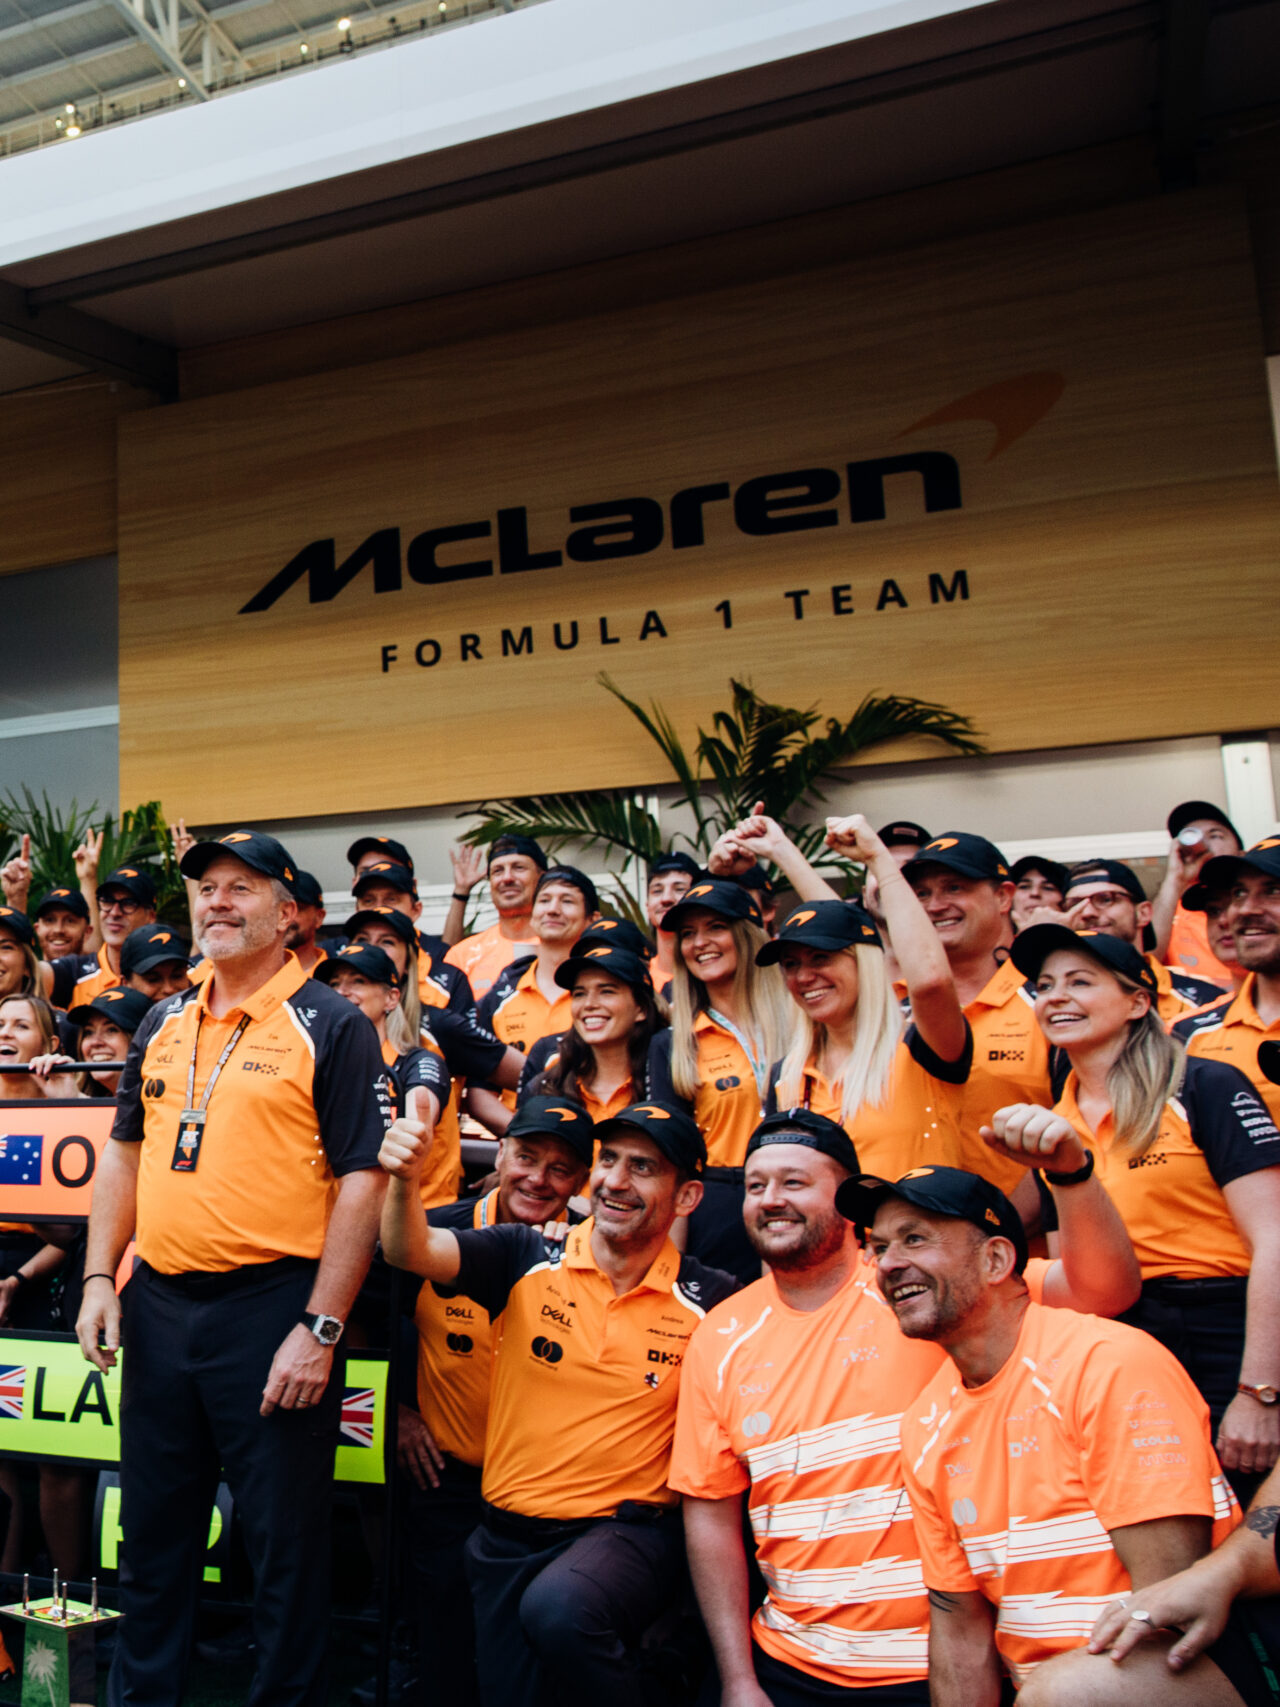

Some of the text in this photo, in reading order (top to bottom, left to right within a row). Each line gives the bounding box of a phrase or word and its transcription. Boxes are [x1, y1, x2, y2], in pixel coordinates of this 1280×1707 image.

[236, 450, 963, 616] McLaren
[379, 568, 972, 672] FORMULA 1 TEAM
[988, 1050, 1025, 1062] OKX
[242, 1061, 280, 1076] OKX
[446, 1306, 474, 1319] DELL
[540, 1304, 573, 1328] DELL
[1132, 1434, 1181, 1448] ECOLAB
